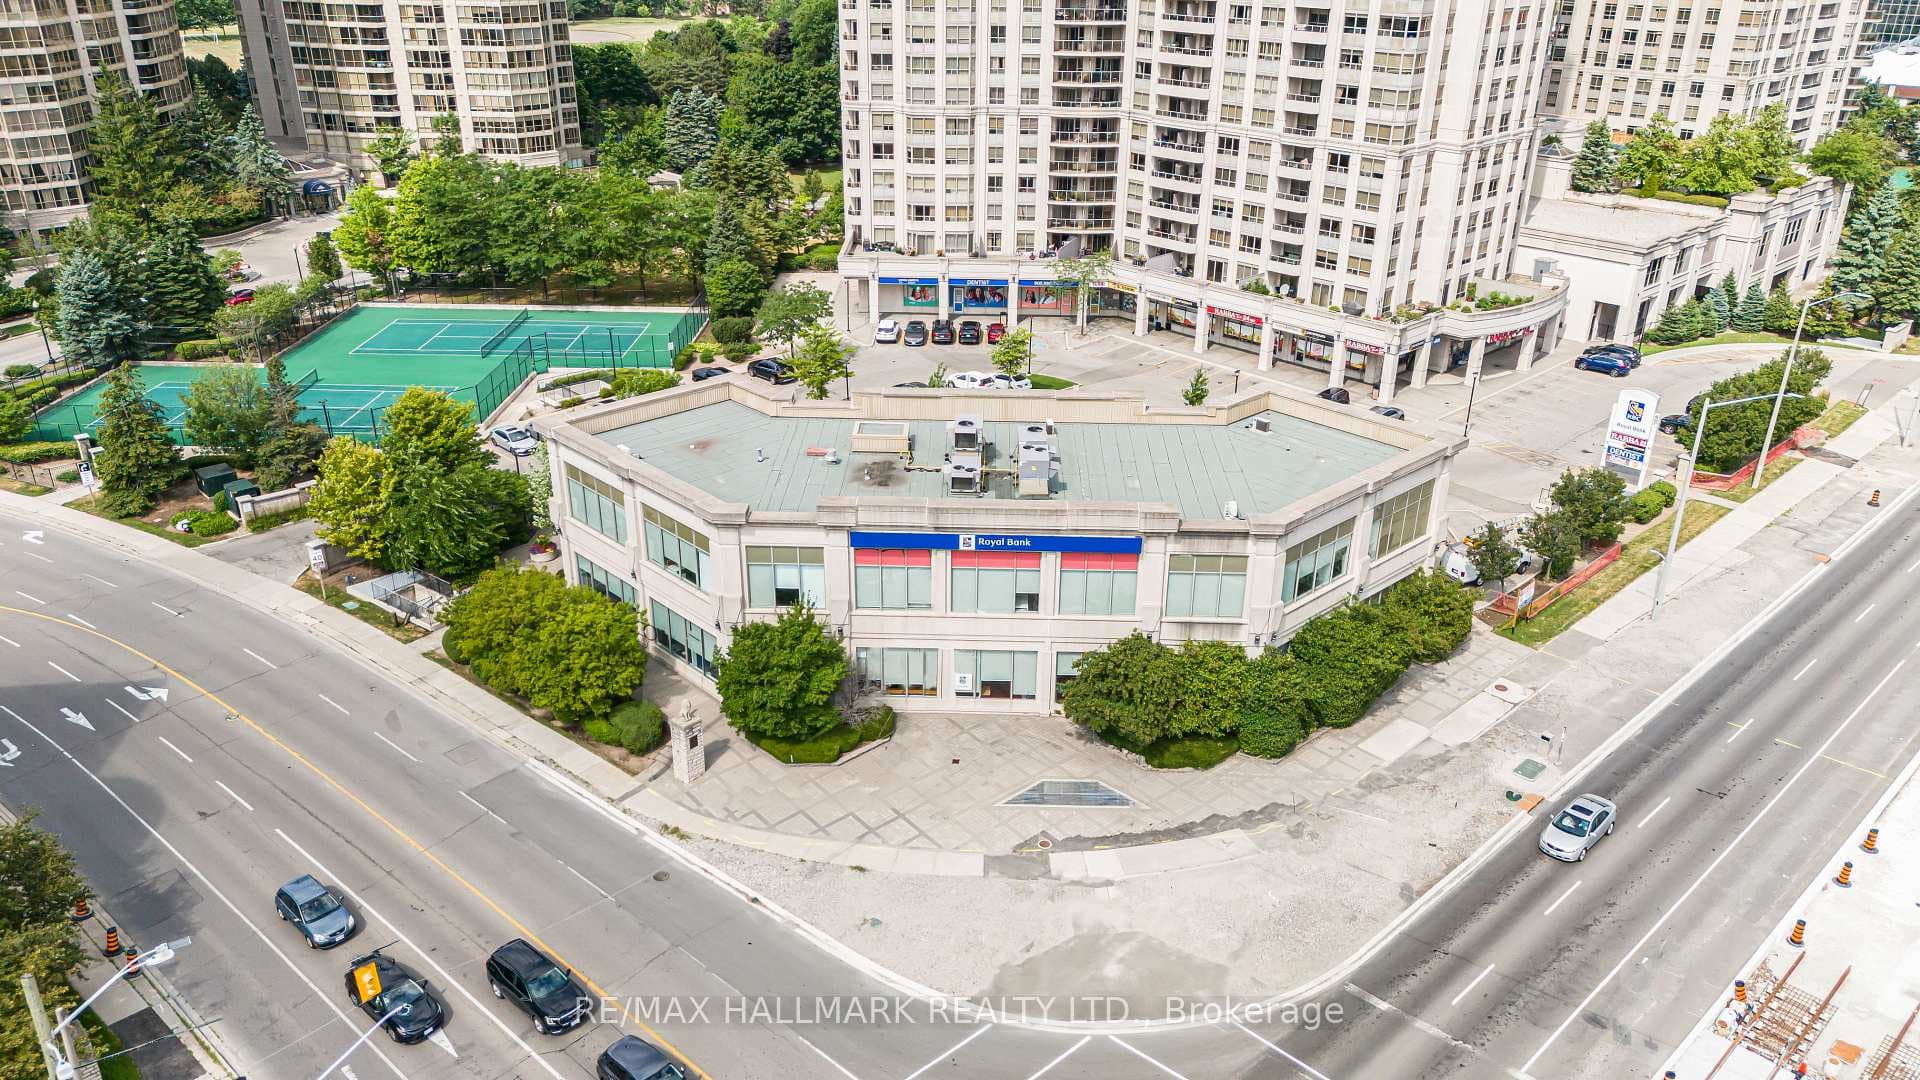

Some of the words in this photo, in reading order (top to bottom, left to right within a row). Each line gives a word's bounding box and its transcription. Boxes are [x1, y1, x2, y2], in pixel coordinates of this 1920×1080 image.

[1610, 432, 1640, 446] RABBA
[1610, 447, 1640, 461] DENTIST
[978, 537, 1005, 547] Royal
[1007, 538, 1031, 547] Bank
